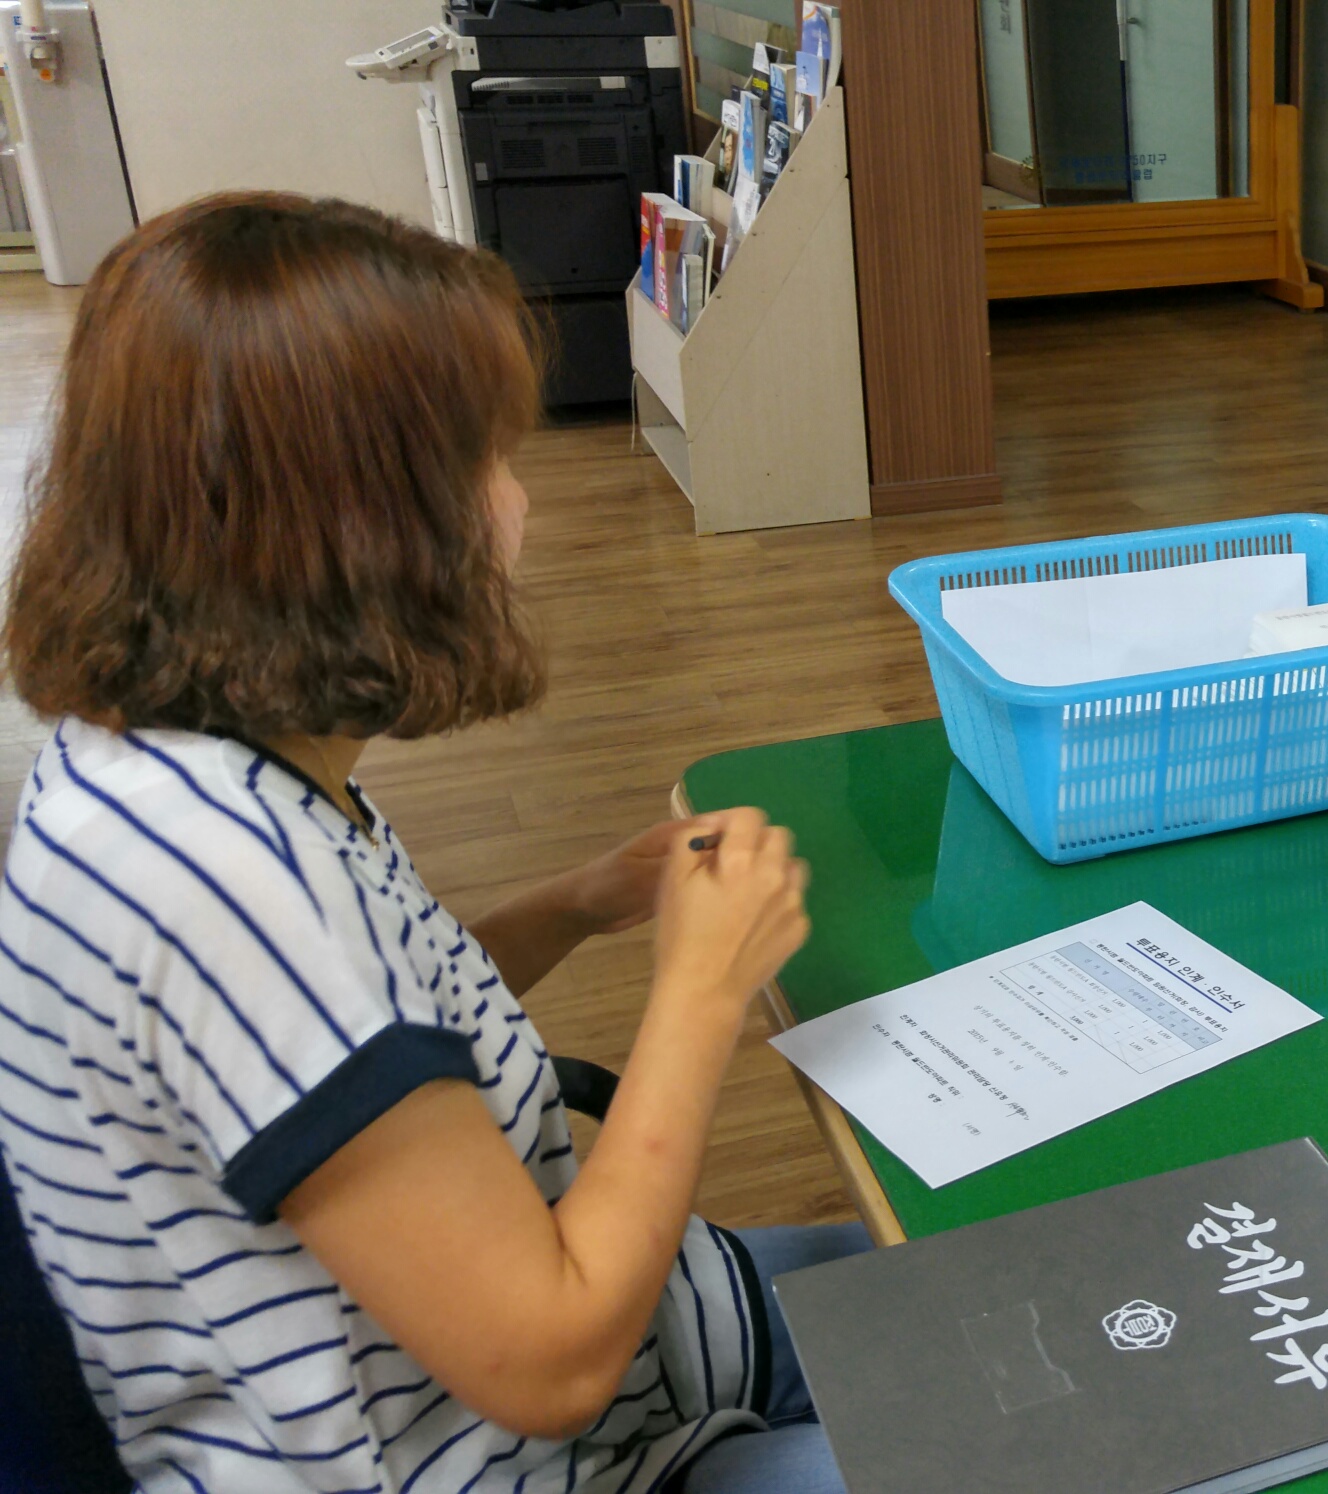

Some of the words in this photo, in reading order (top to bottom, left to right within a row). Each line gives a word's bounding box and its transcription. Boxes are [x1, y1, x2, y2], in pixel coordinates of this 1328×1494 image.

[1136, 938, 1180, 967] 투표용지
[1177, 966, 1205, 983] 인계
[1207, 986, 1246, 1010] 인수서
